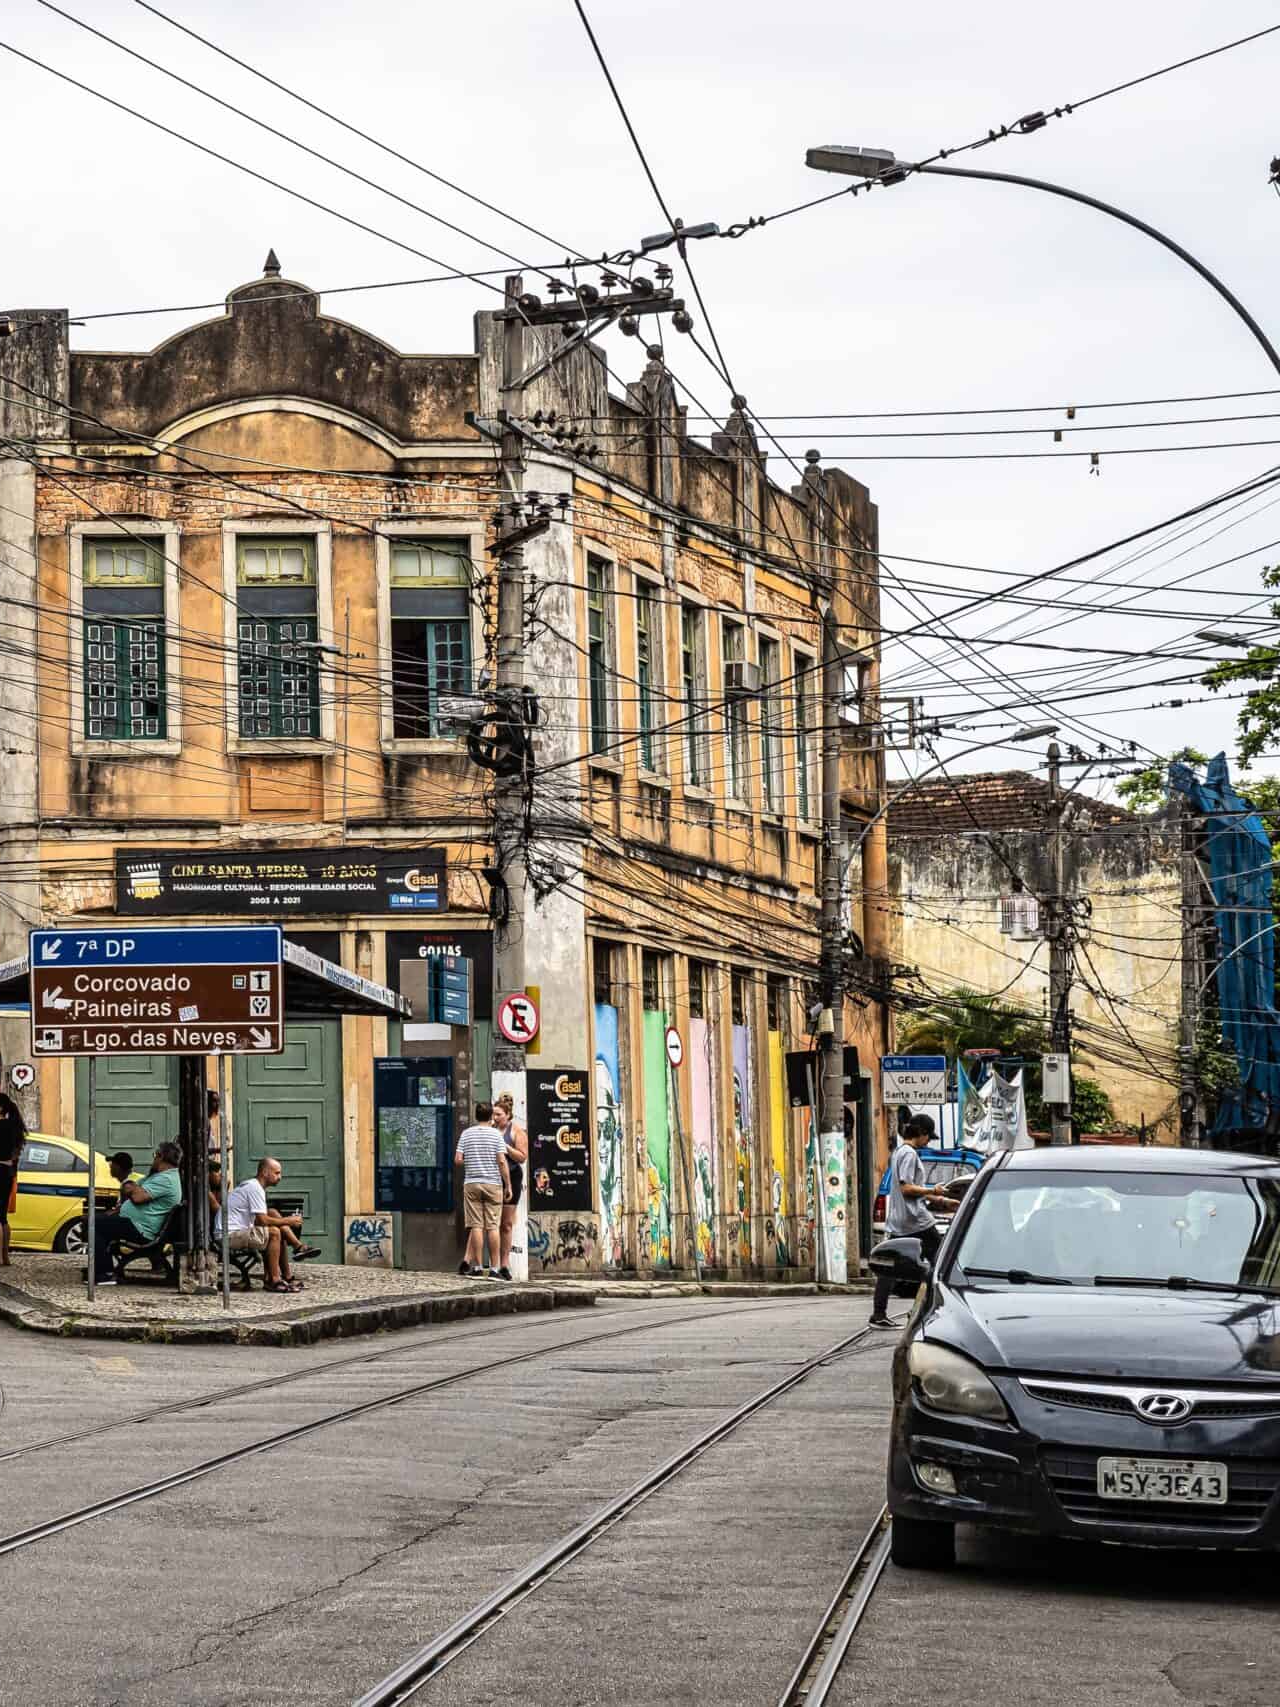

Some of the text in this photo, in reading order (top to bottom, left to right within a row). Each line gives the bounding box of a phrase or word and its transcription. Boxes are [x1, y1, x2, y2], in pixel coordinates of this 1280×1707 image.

[208, 865, 255, 879] SANTA
[256, 865, 309, 878] TERESA
[338, 865, 377, 878] ANOS
[223, 883, 264, 892] CULTURAL
[270, 883, 346, 891] RESPONSABILIDADE
[347, 883, 377, 891] SOCIAL
[106, 939, 136, 957] DP
[73, 973, 191, 992] Corcovado
[74, 998, 172, 1017] Paineiras
[83, 1027, 237, 1050] Lgo. das Neves
[555, 1074, 582, 1101] Casal
[898, 1076, 918, 1084] GEL
[885, 1091, 943, 1099] Santa Teresa
[556, 1124, 583, 1151] Casal
